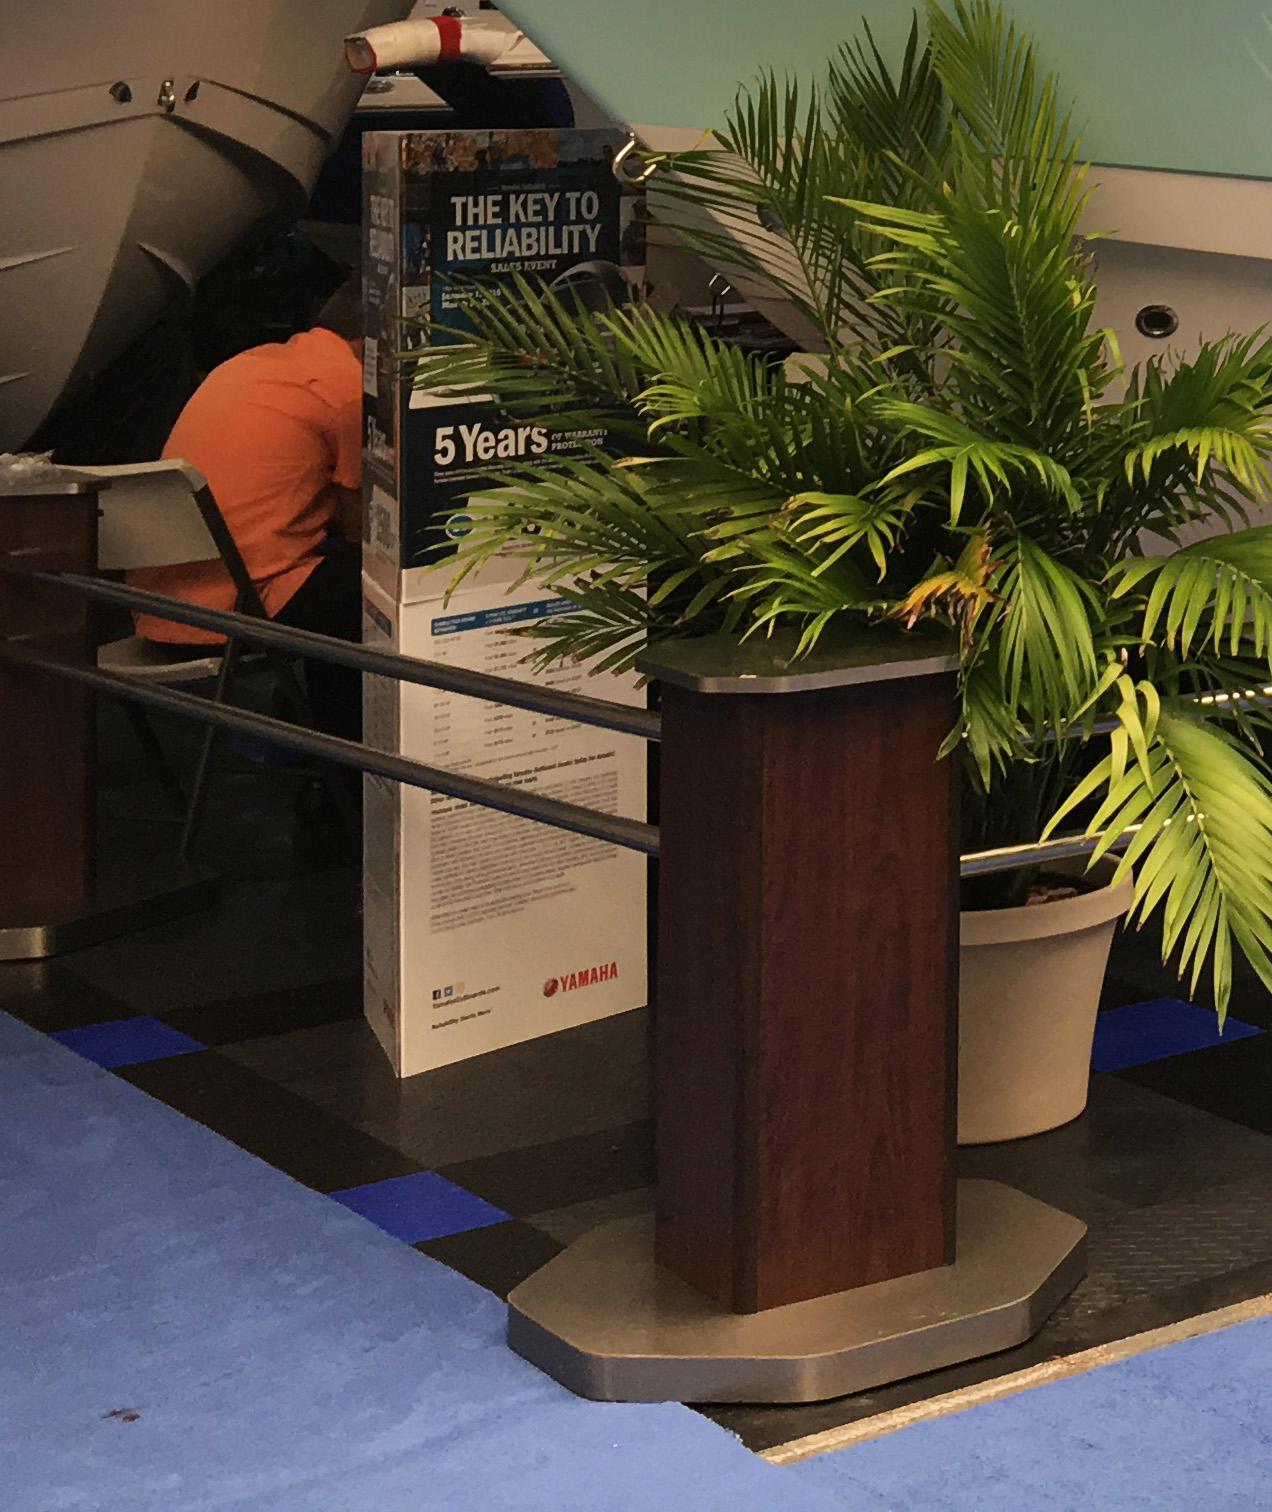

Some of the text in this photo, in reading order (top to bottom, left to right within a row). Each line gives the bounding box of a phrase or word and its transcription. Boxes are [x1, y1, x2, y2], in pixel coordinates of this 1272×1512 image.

[450, 190, 600, 226] THE KEY TO
[446, 223, 602, 262] RELIABILITY
[433, 425, 456, 466] 5
[458, 422, 548, 463] Years
[560, 961, 618, 993] YAMAHA
